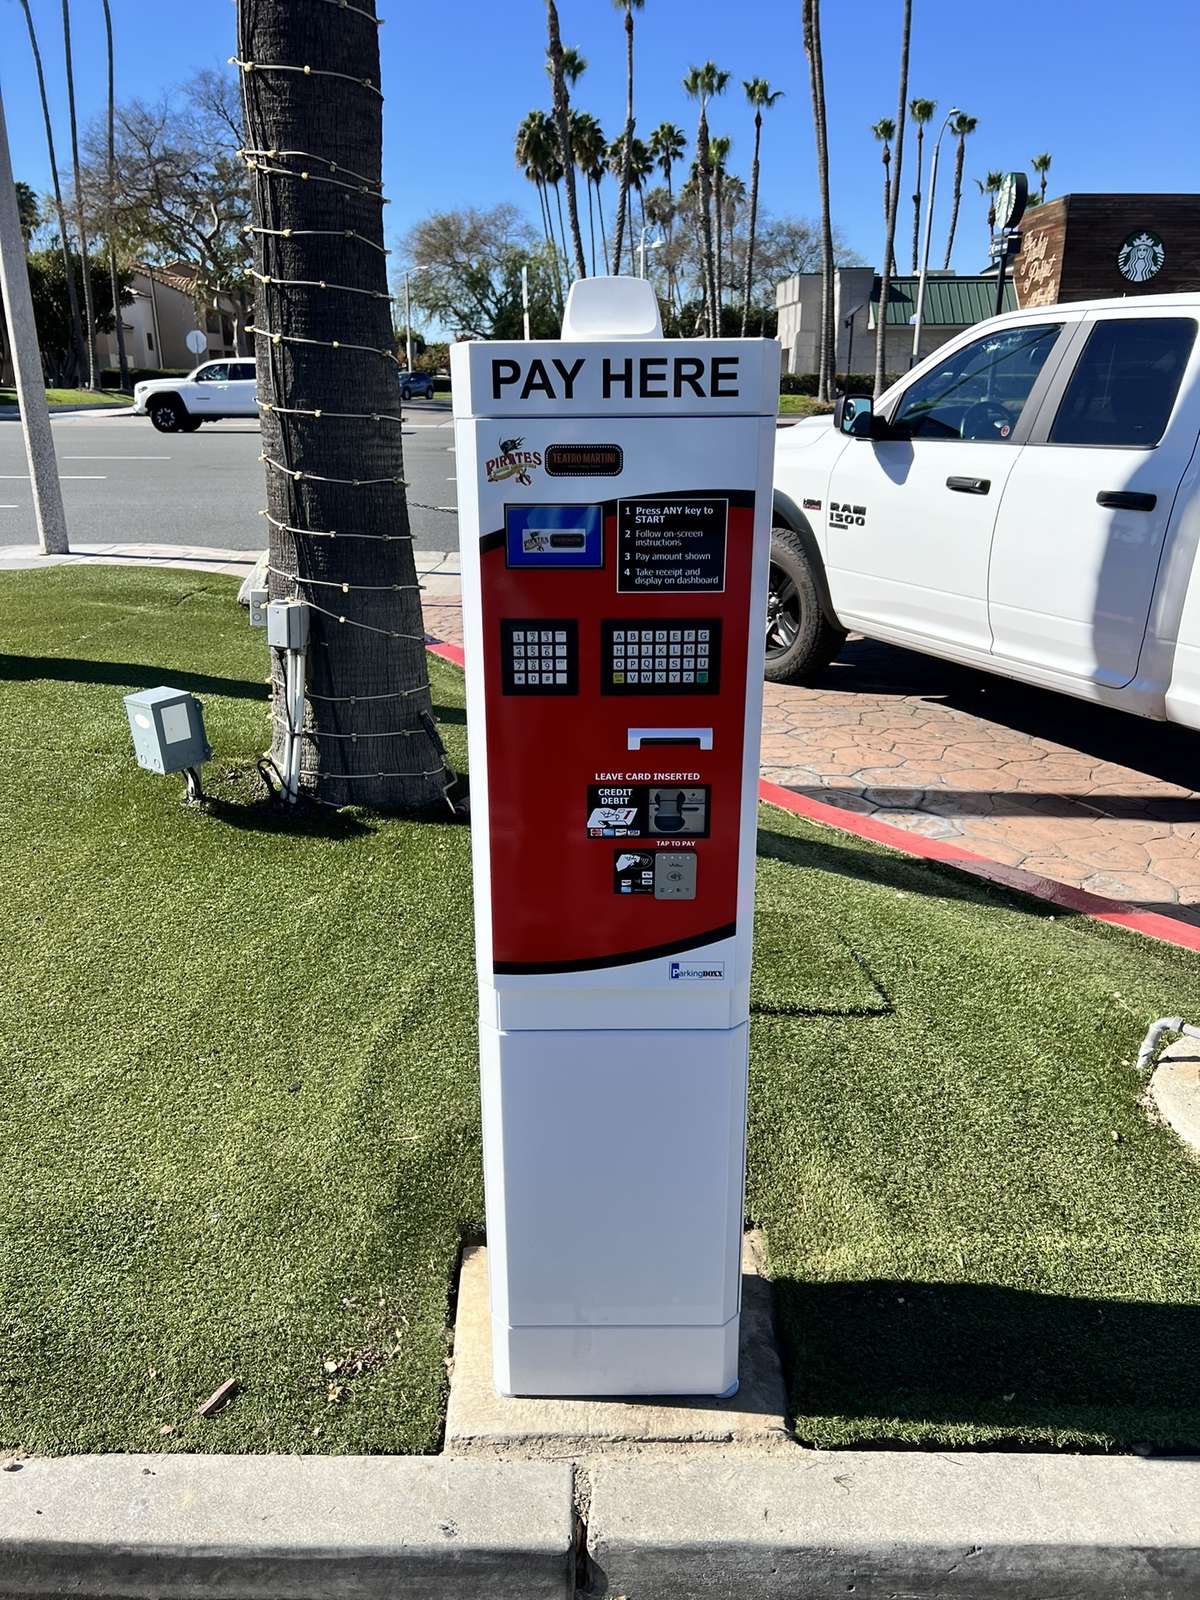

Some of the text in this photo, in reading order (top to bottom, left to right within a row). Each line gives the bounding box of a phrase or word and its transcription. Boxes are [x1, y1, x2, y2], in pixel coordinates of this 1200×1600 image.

[492, 357, 739, 399] PAY HERE
[552, 452, 616, 464] TEATRO MARTINI
[485, 452, 542, 476] PIRATES
[625, 507, 630, 515] 1
[685, 506, 701, 516] key
[830, 502, 866, 516] RAM
[830, 512, 865, 526] 1500
[625, 530, 630, 538] 2
[635, 553, 649, 562] Pay
[656, 568, 682, 577] receipt
[635, 577, 662, 585] display
[677, 576, 718, 584] dashboard
[644, 660, 651, 668] Q
